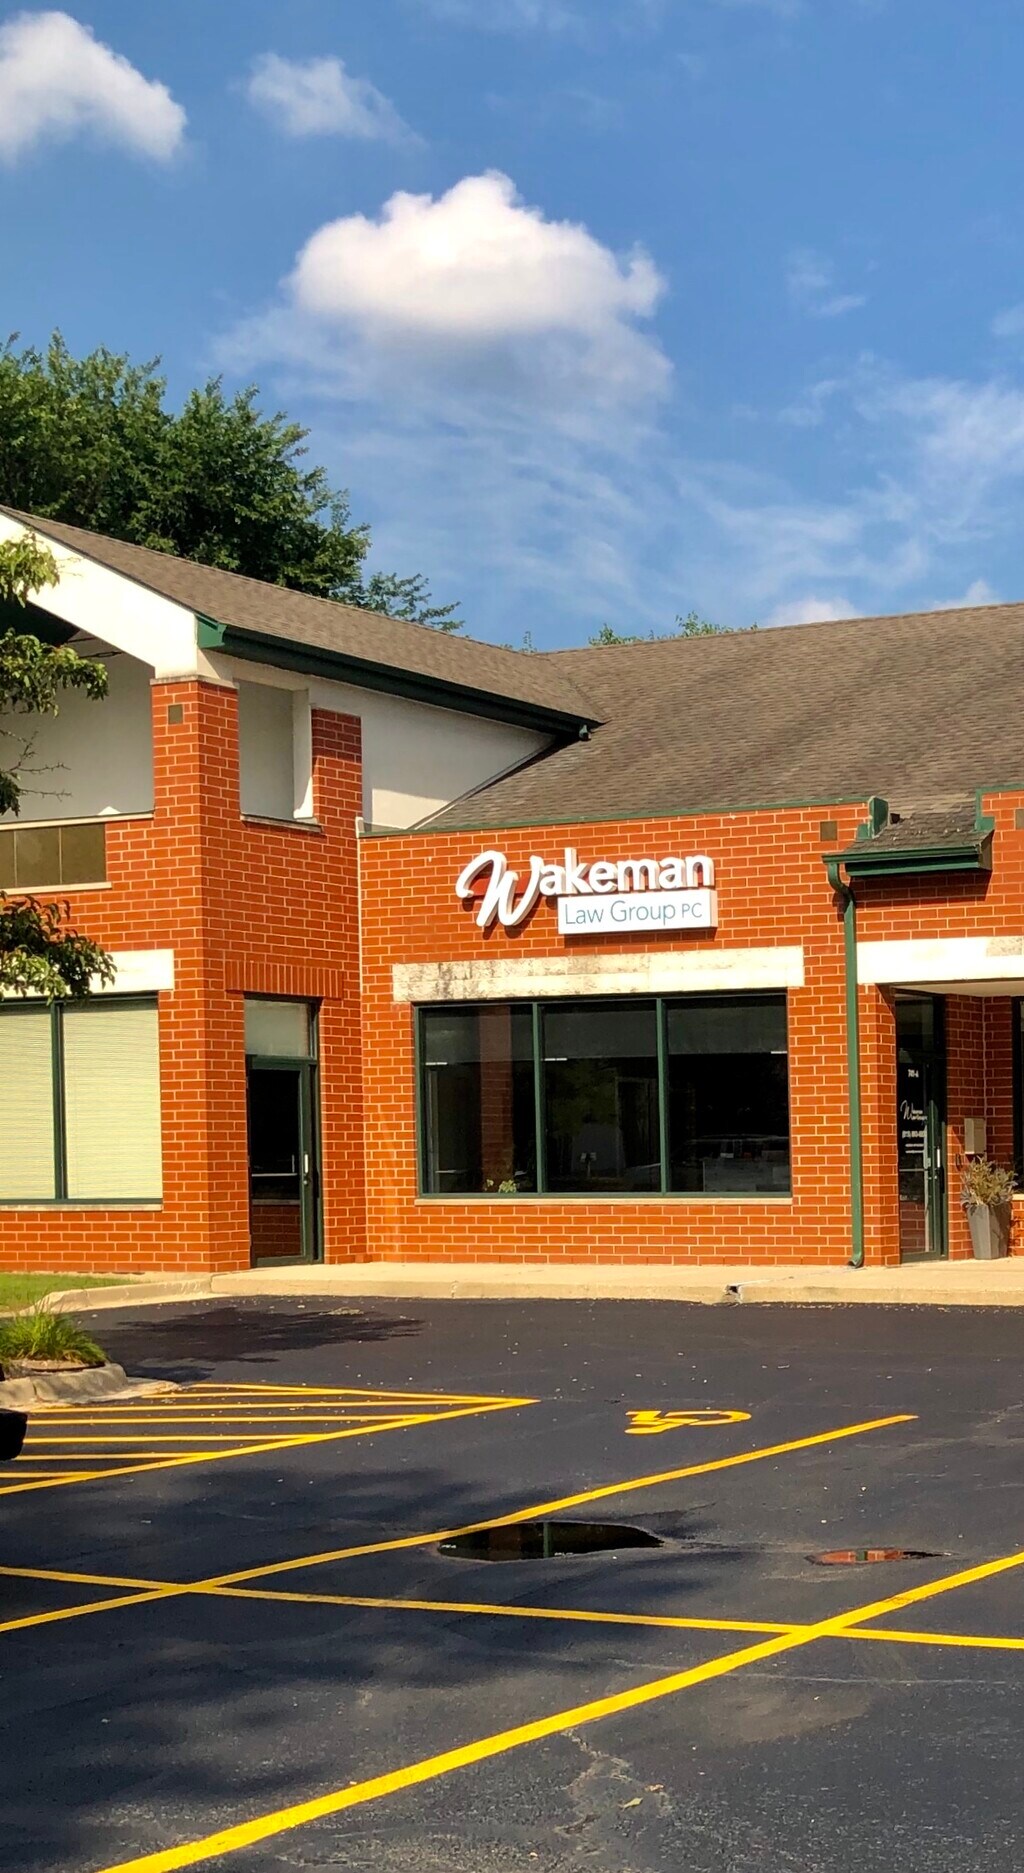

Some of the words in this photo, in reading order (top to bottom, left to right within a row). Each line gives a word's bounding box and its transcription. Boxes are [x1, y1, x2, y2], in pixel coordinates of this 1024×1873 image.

[455, 847, 715, 927] Wakeman
[565, 903, 604, 925] Law
[610, 899, 676, 926] Group
[682, 902, 702, 919] PC
